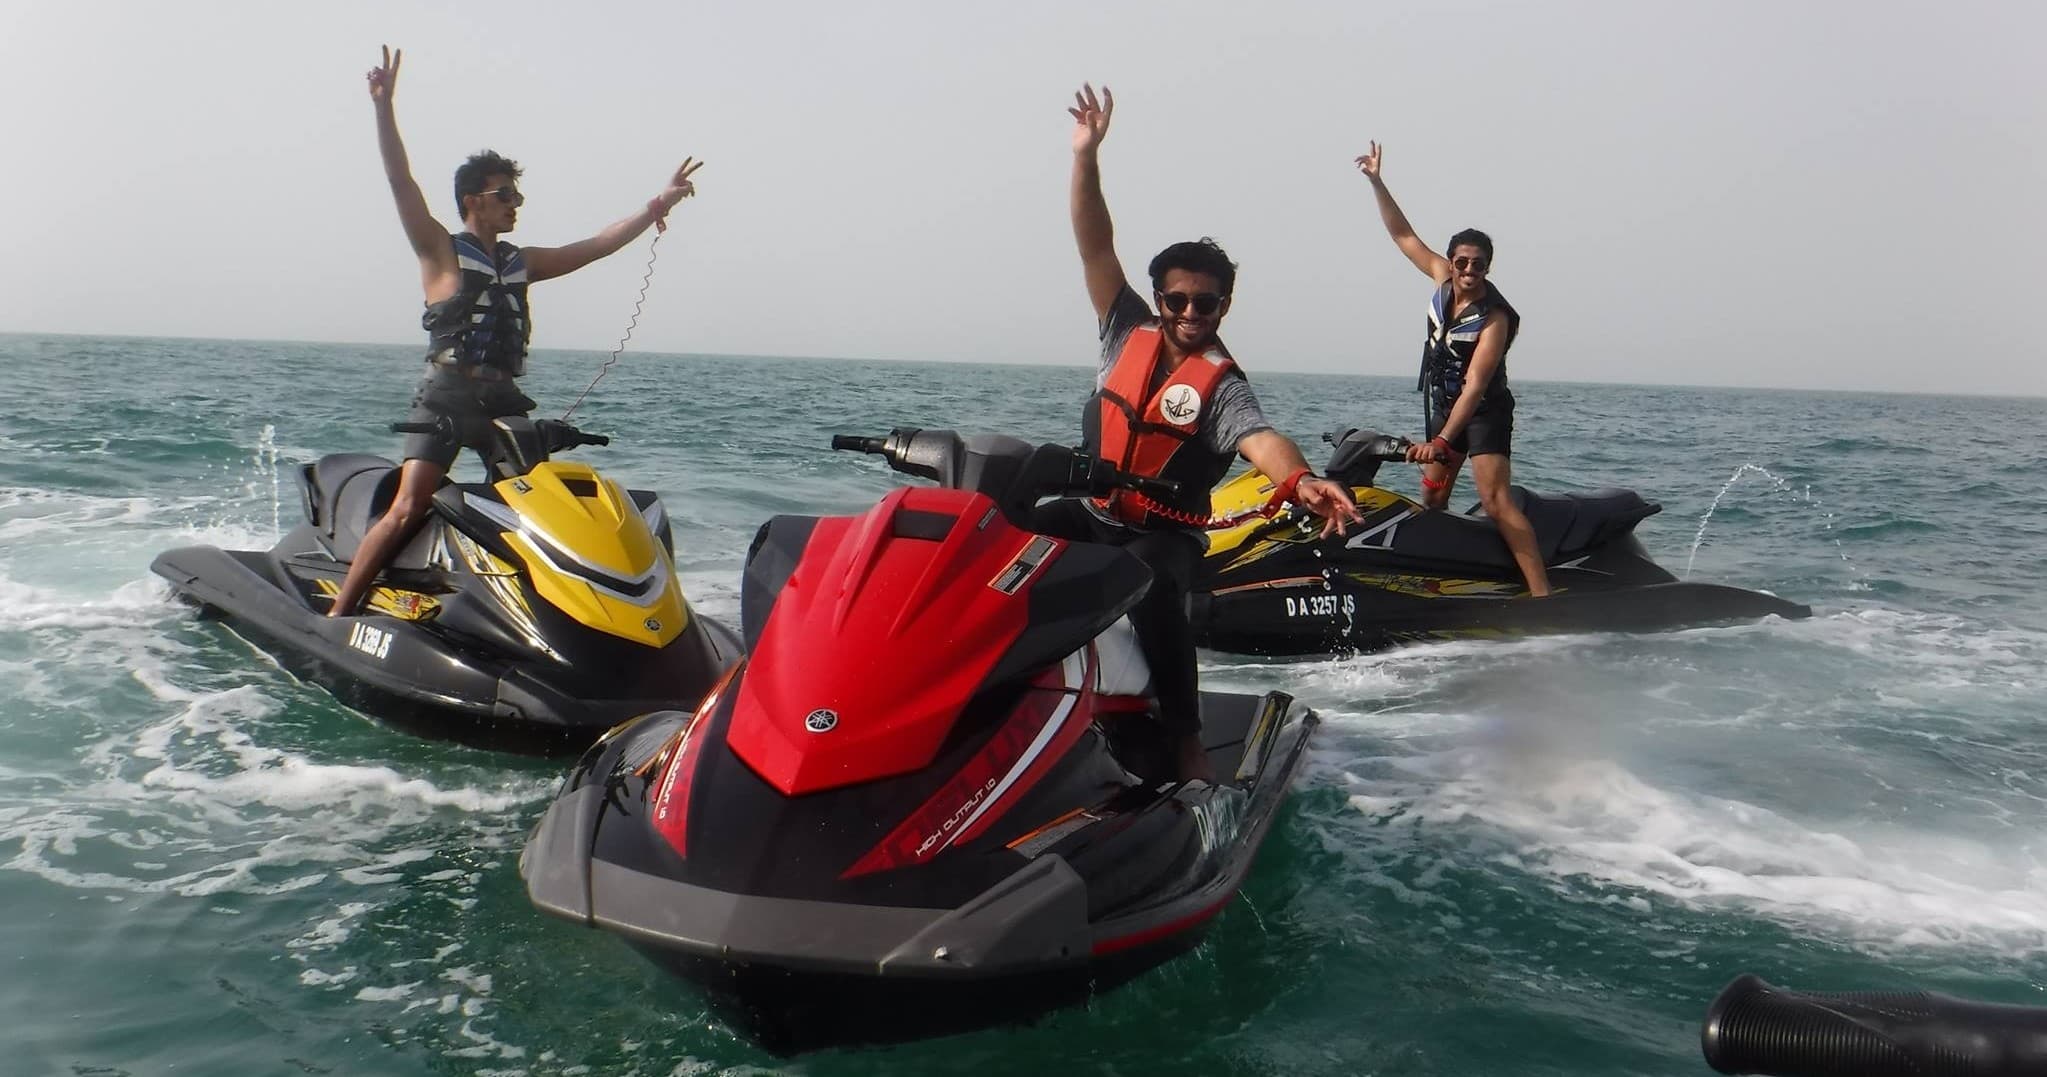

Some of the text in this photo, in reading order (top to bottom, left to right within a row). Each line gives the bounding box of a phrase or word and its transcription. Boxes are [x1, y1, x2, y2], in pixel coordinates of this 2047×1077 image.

[1310, 595, 1337, 616] 3257
[1341, 594, 1356, 615] JS
[915, 829, 943, 857] HIGH
[943, 789, 984, 832] OUTPUT
